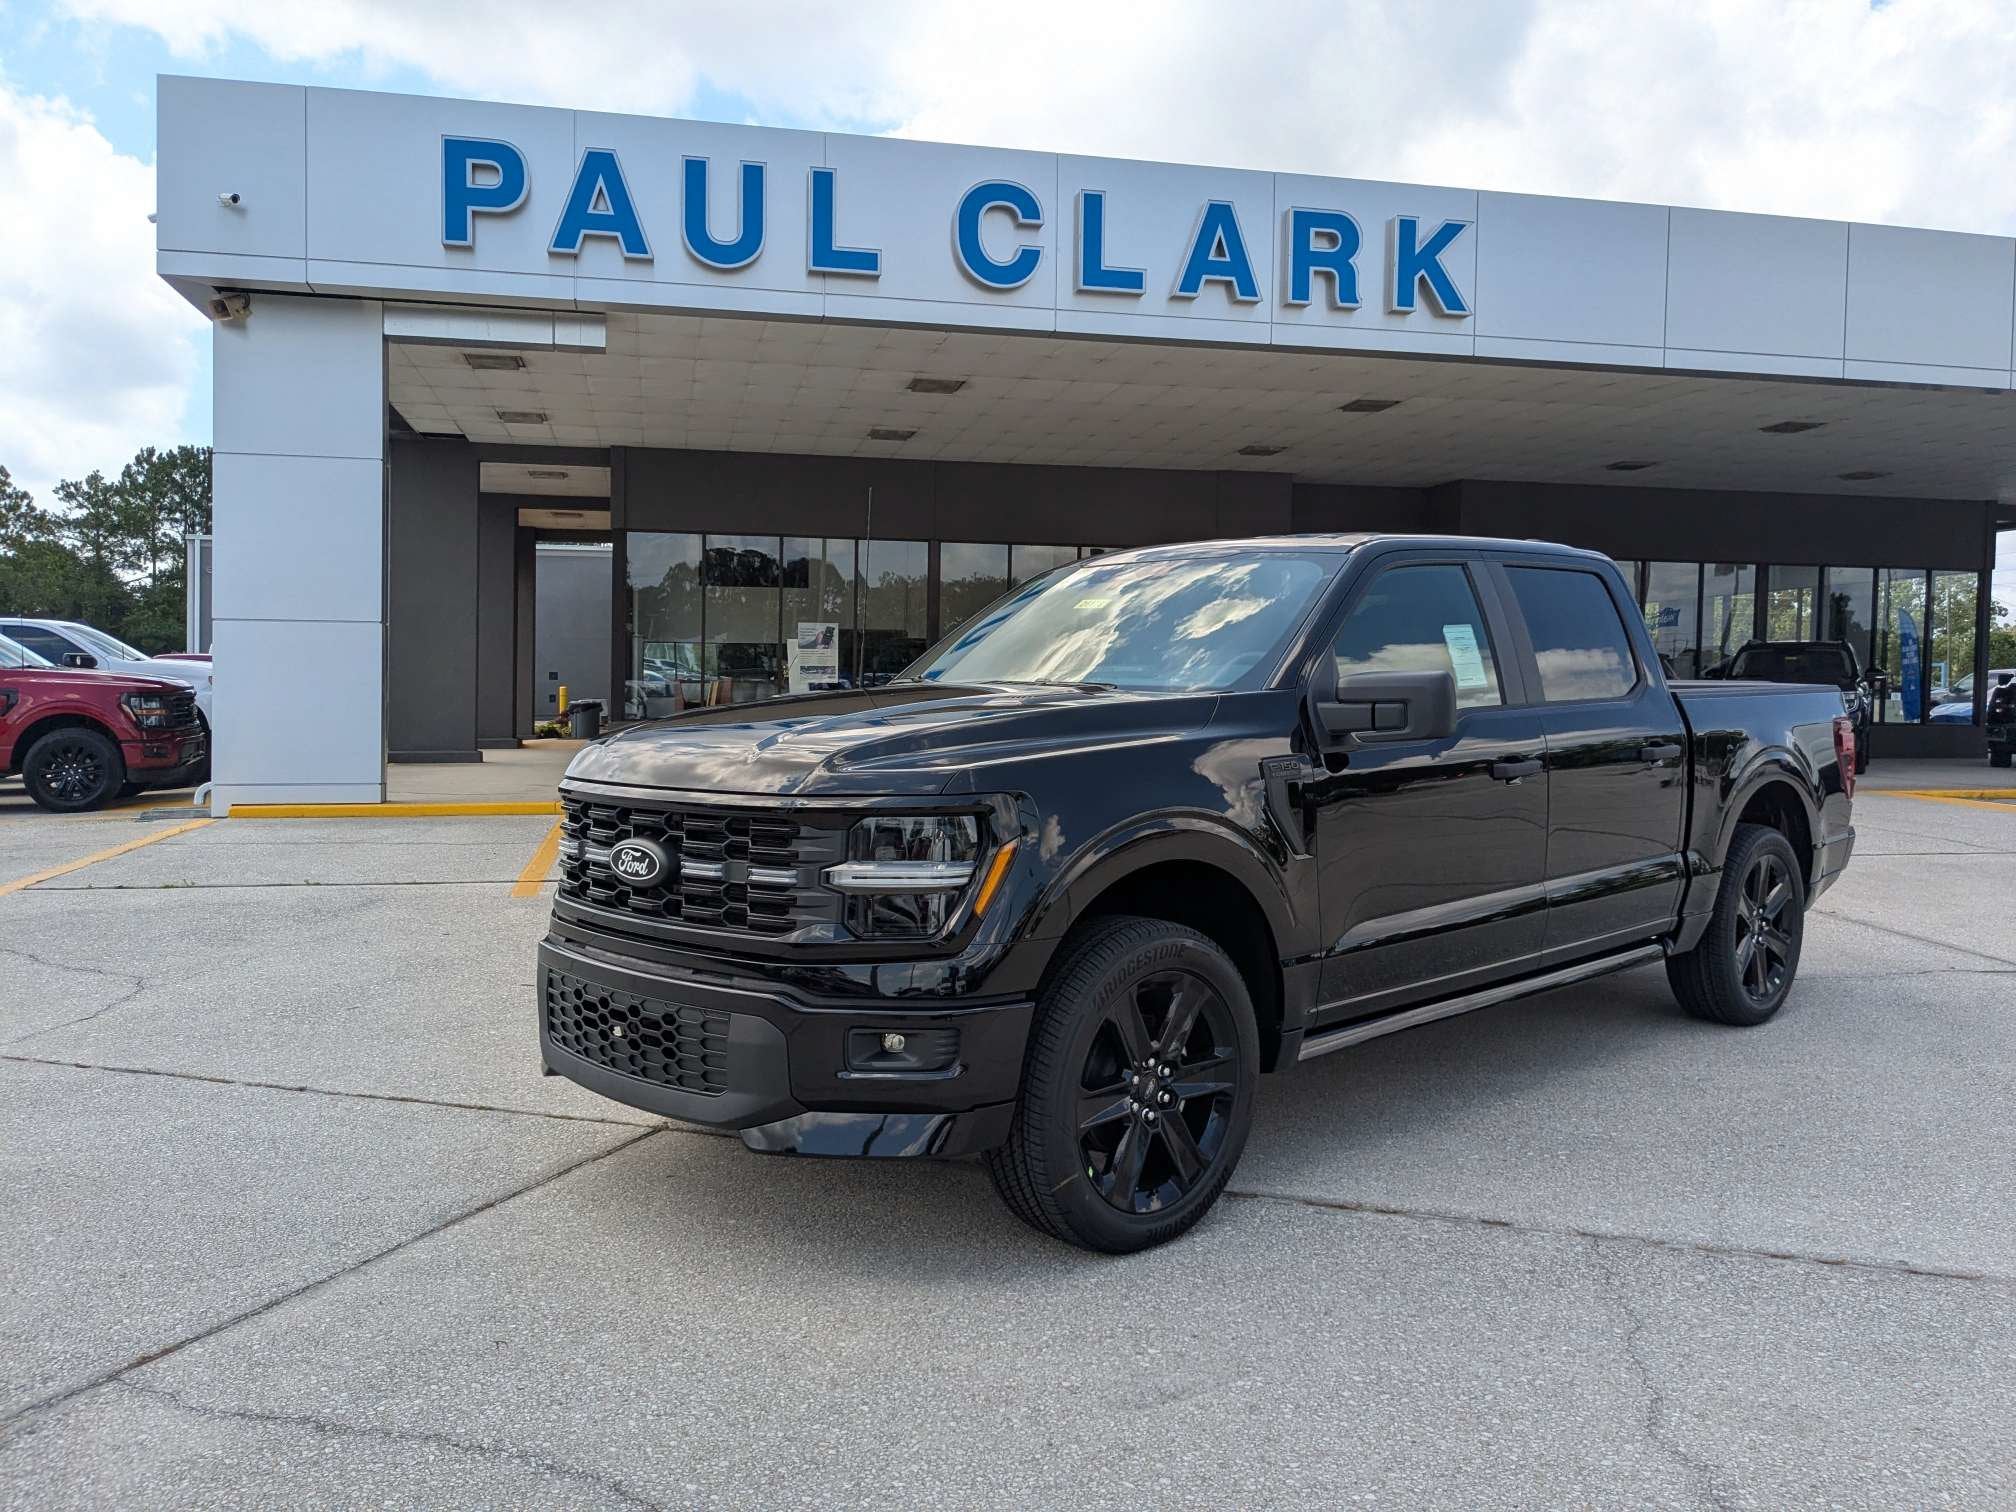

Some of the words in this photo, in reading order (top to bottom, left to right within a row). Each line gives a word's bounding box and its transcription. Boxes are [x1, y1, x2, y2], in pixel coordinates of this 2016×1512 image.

[441, 134, 882, 276] PAUL
[953, 178, 1475, 317] CLARK
[618, 848, 649, 875] Ford
